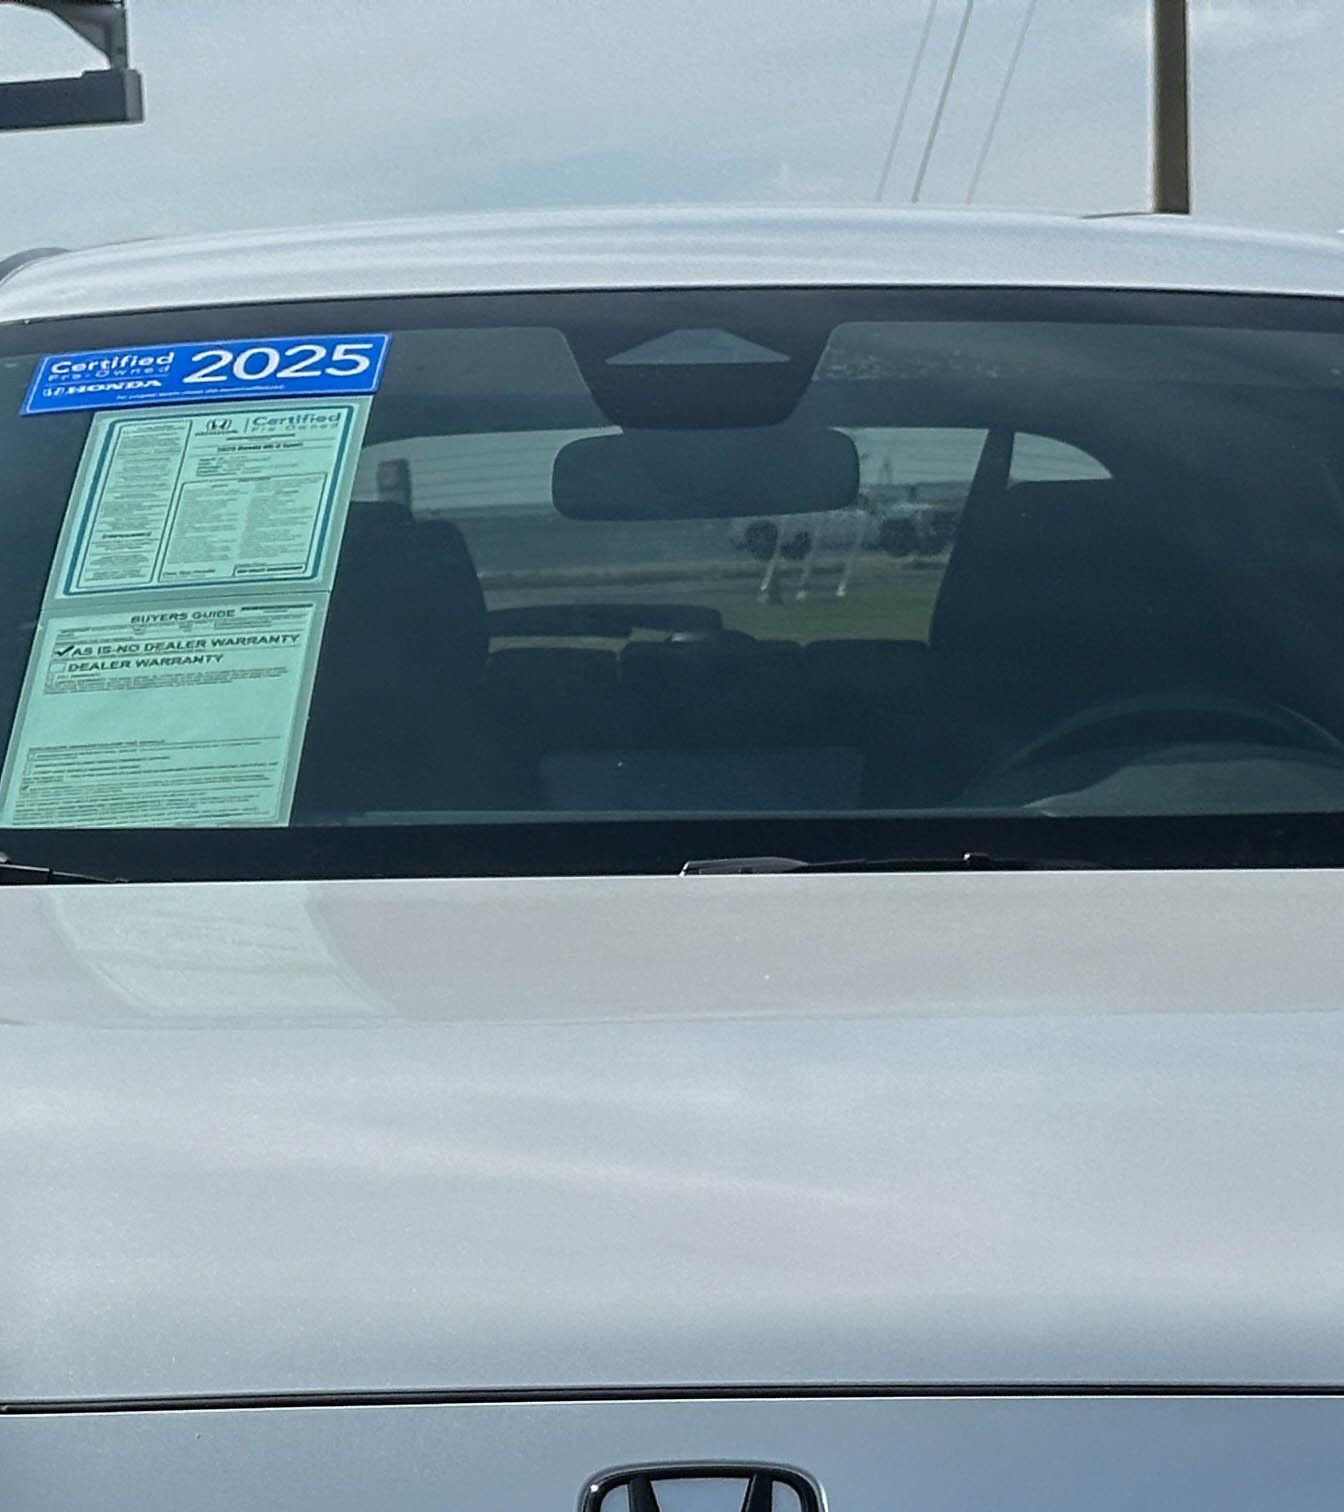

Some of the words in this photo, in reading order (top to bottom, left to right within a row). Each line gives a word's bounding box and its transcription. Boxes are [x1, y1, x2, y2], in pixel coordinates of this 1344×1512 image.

[51, 352, 175, 374] Certified
[182, 343, 374, 384] 2025
[65, 380, 162, 394] HONDA
[252, 412, 342, 426] Certified
[131, 612, 187, 624] BUYERS
[191, 609, 236, 620] GUIDE
[72, 647, 93, 656] AS
[144, 638, 207, 651] DEALER
[210, 633, 301, 647] WARRANTY
[67, 660, 131, 673] DEALER
[135, 654, 225, 668] WARRANTY
